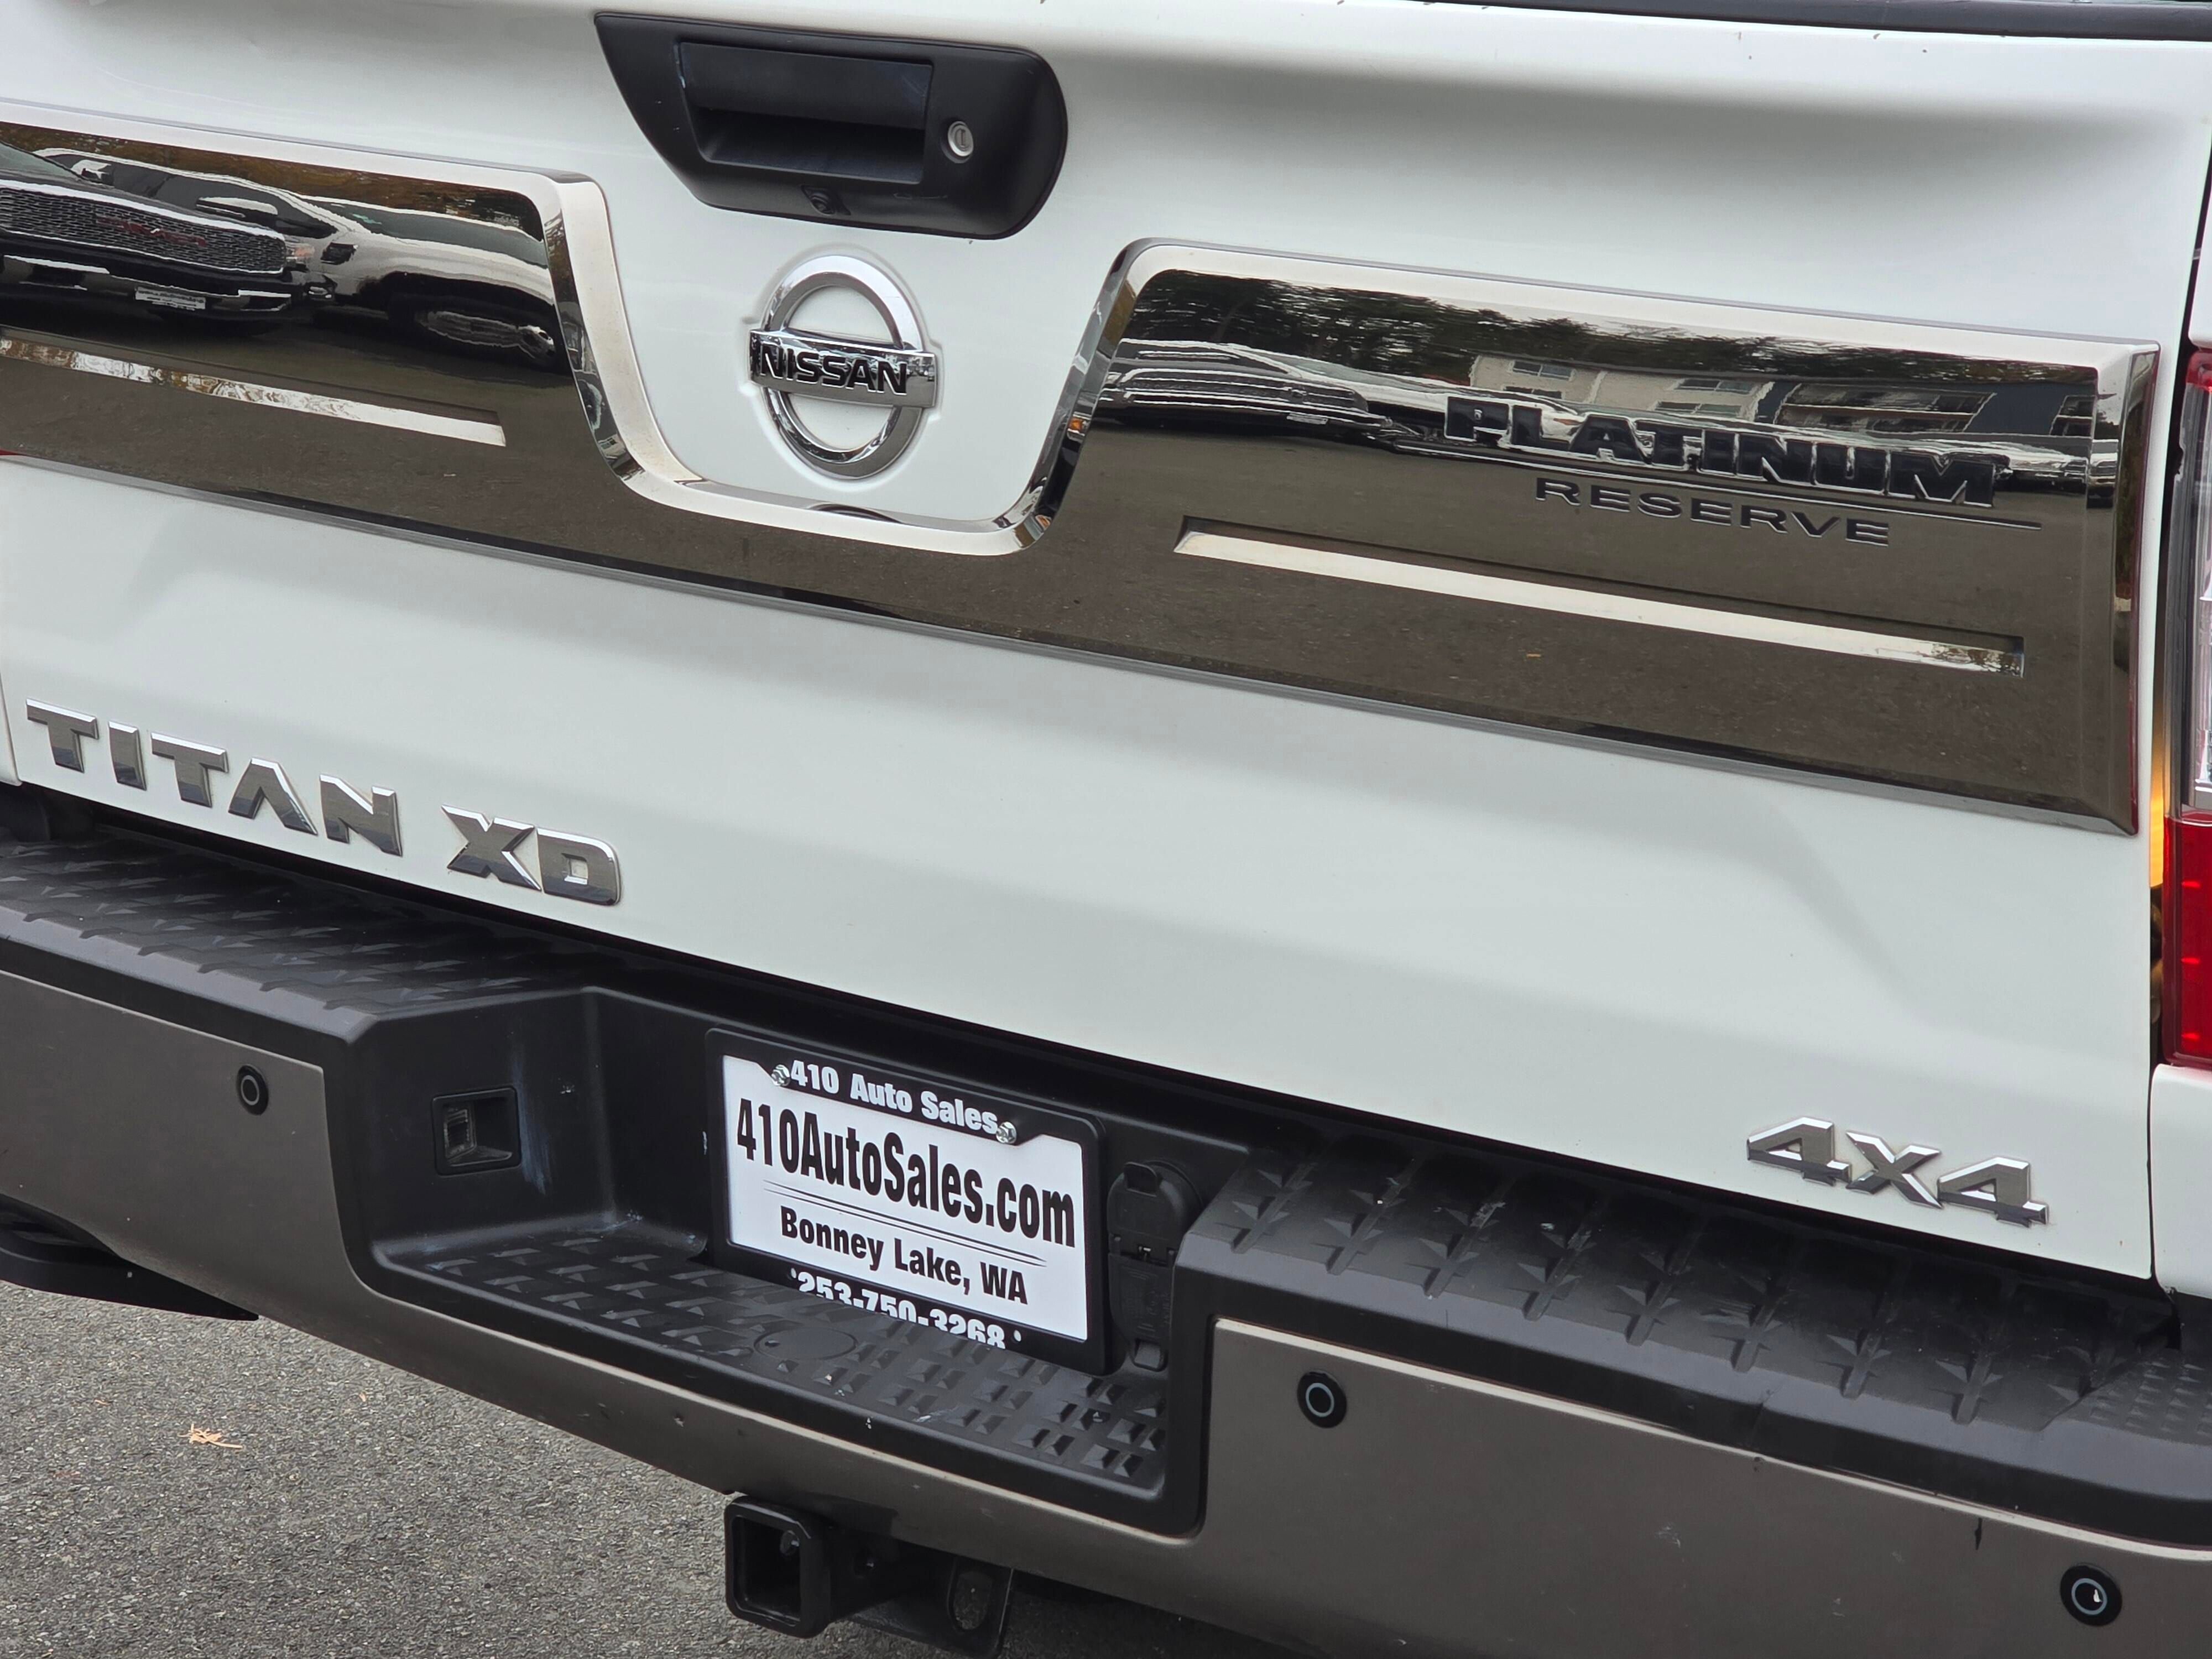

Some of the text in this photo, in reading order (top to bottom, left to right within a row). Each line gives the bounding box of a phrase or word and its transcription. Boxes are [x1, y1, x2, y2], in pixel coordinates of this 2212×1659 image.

[760, 343, 907, 395] NISSAN
[1444, 395, 1995, 508] PLATINUM
[1536, 477, 1889, 547] RESERVE
[25, 698, 622, 906] TITAN XD
[790, 1060, 998, 1135] 410 Auto Sales
[737, 1098, 1076, 1248] 410AutoSales.com
[780, 1206, 1029, 1306] Bonney Lake, WA
